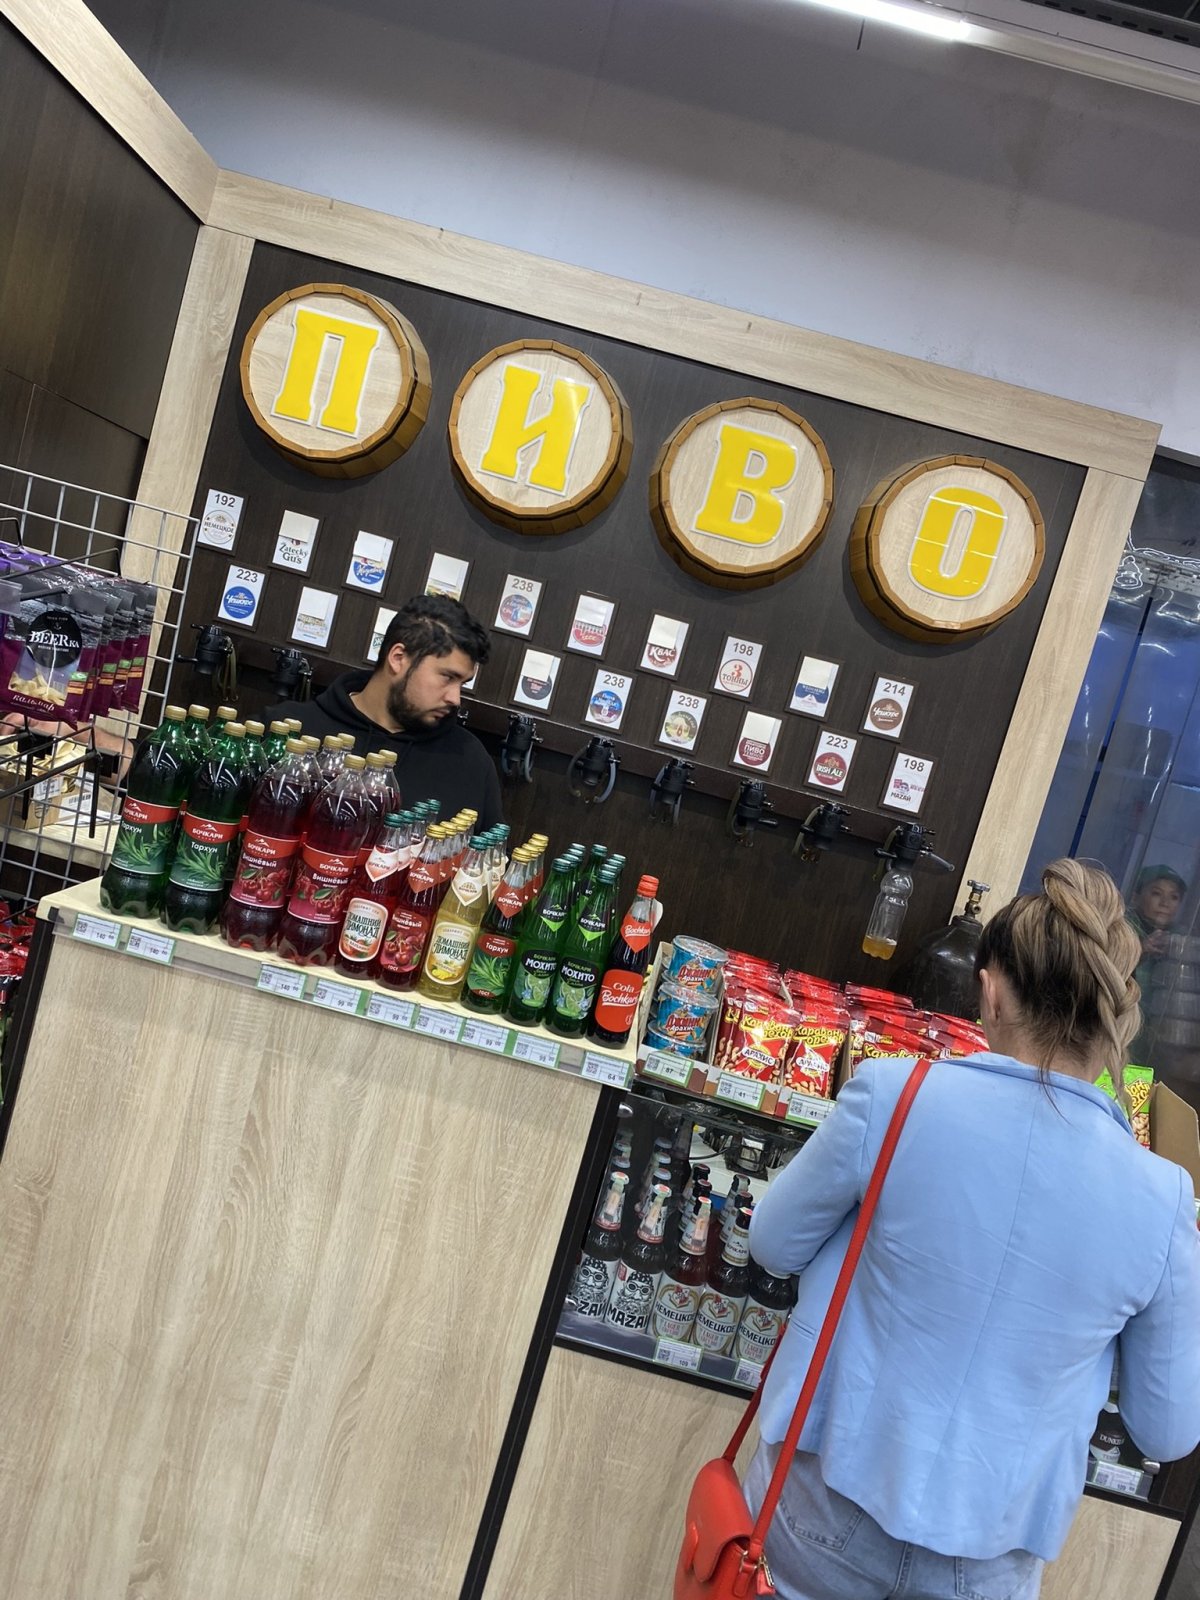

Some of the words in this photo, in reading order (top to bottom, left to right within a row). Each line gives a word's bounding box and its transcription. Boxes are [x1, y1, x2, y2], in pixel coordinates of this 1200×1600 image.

[272, 305, 1008, 602] ПИВО
[215, 494, 235, 508] 192
[236, 569, 258, 583] 223
[512, 579, 533, 592] 238
[649, 646, 676, 662] КВАС
[733, 642, 753, 656] 198
[731, 664, 743, 678] 3
[603, 675, 625, 688] 238
[722, 673, 748, 685] ТОННЫ
[883, 682, 905, 696] 214
[678, 695, 699, 708] 238
[826, 736, 848, 749] 223
[904, 758, 924, 772] 198
[192, 827, 223, 839] БОЧКАРИ
[191, 841, 218, 853] Тархун
[247, 842, 276, 855] БОЧКАРИ
[319, 863, 349, 873] БОЧКАРИ
[497, 896, 522, 907] БОЧКАРИ
[485, 942, 508, 955] Тархун
[561, 965, 595, 982] МОХИТО
[613, 982, 633, 993] Cola
[743, 1049, 773, 1065] АРАХИС
[738, 1324, 776, 1346] НЕМЕЦКО
